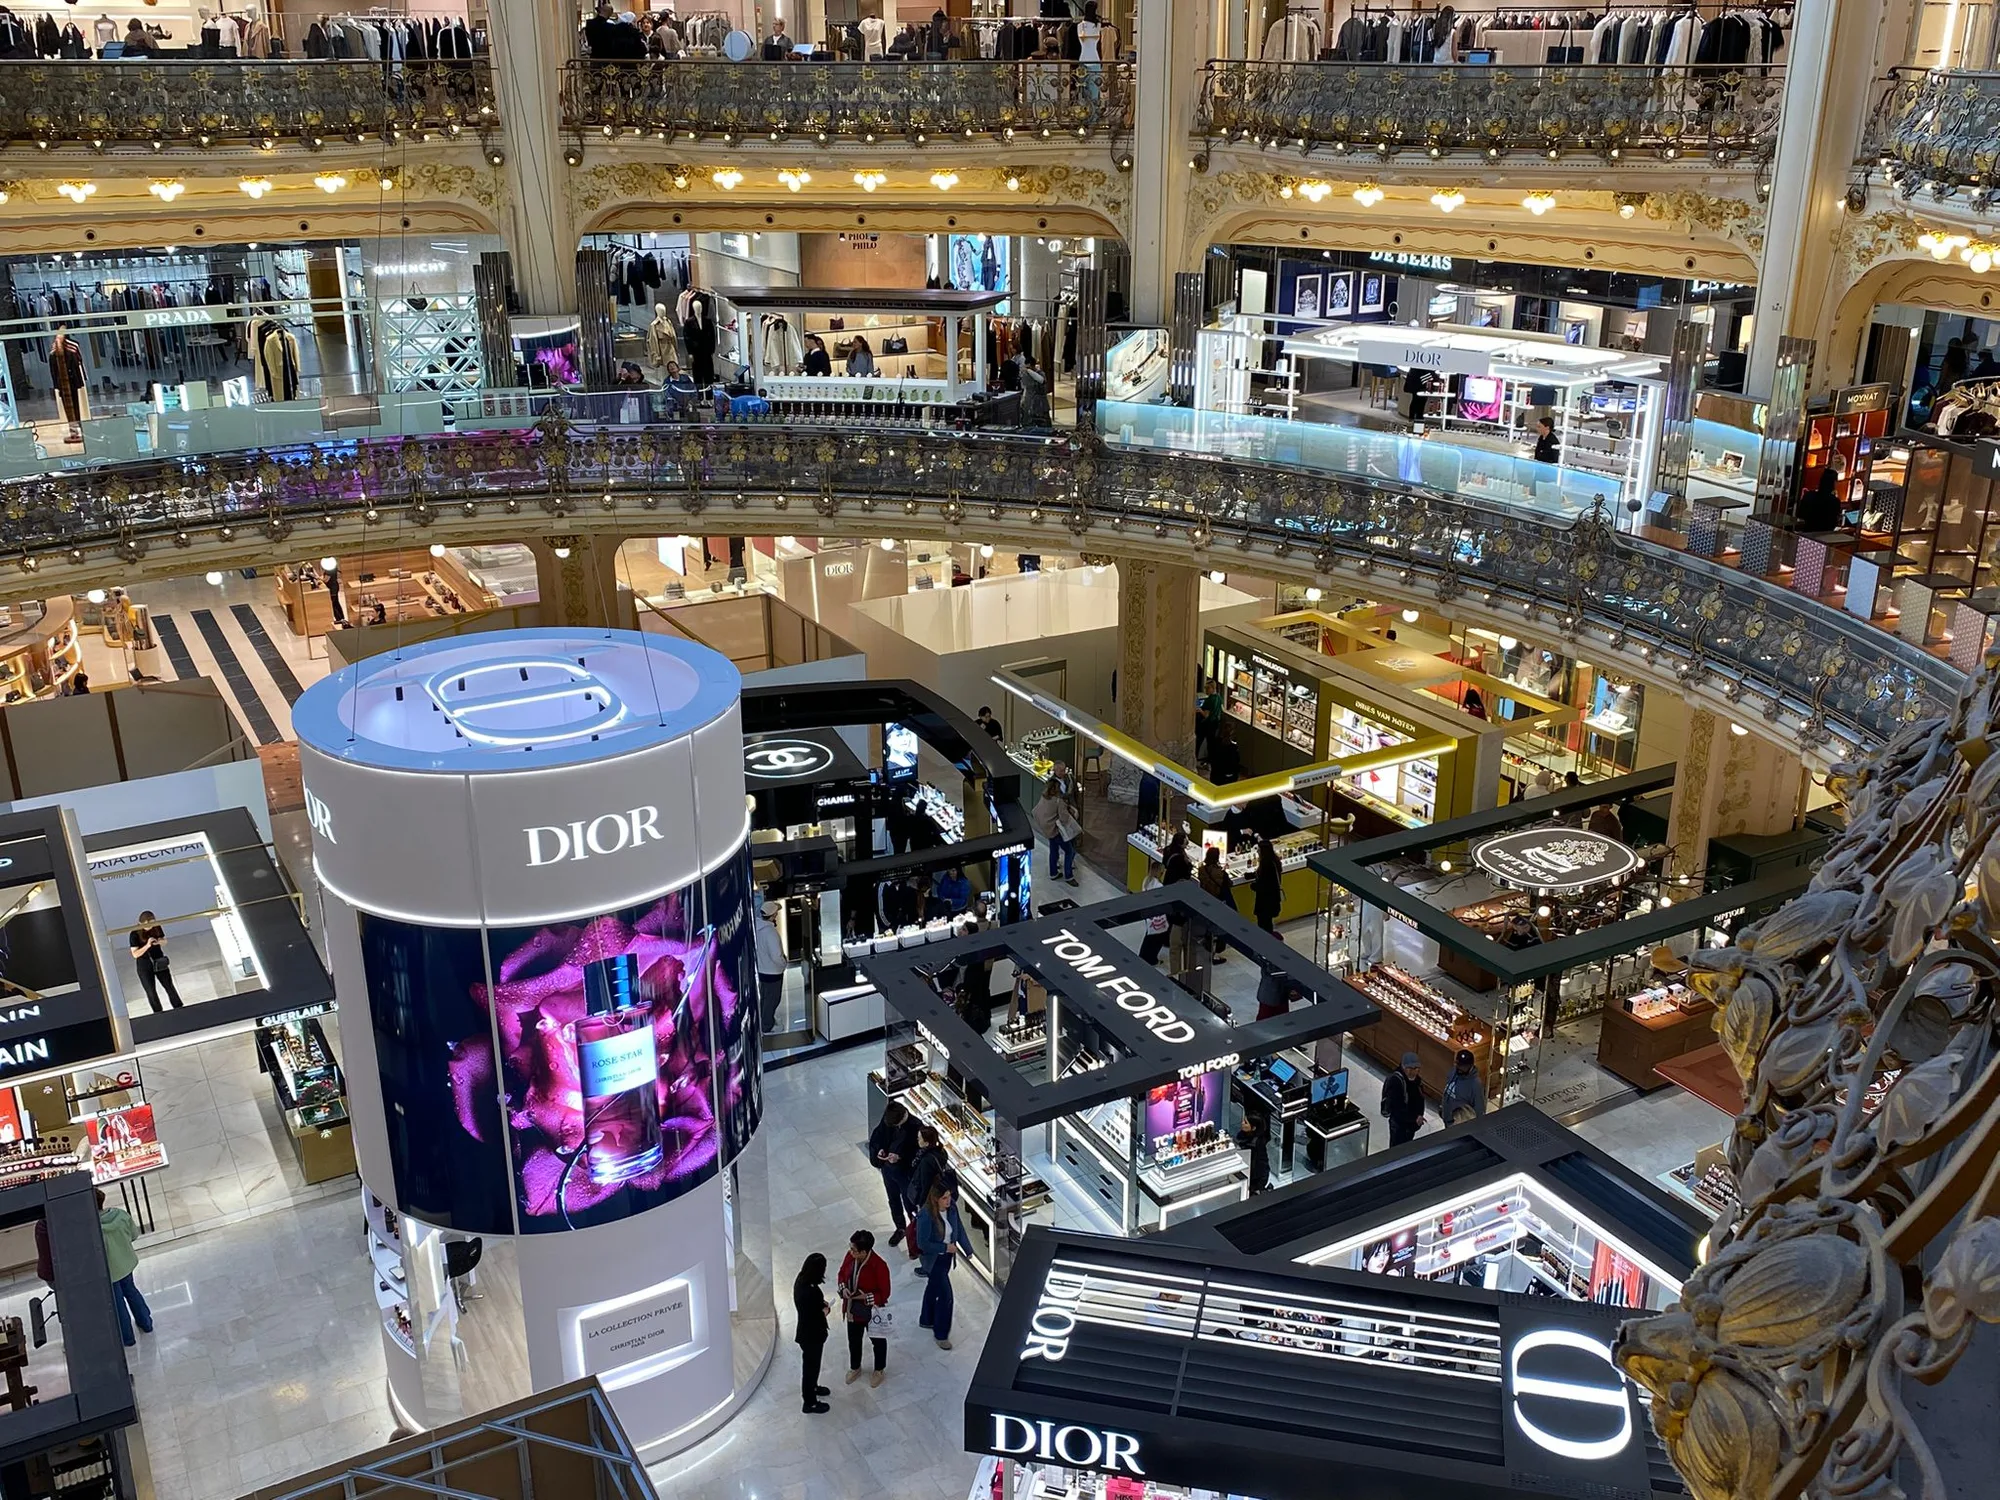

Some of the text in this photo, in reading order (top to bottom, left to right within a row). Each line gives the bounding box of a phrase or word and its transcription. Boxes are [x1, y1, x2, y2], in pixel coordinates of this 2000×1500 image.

[373, 262, 447, 276] GIVENCHY
[144, 310, 212, 326] PRADA
[1405, 349, 1441, 366] DIOR
[1847, 392, 1878, 404] MOYNAT
[825, 563, 853, 577] DIOR
[1355, 700, 1416, 732] DRIES VAN NOTEN
[817, 793, 855, 807] CHANEL
[524, 805, 664, 867] DIOR
[992, 843, 1027, 858] CHANEL
[1489, 848, 1558, 883] DIPTYQUE
[1041, 928, 1196, 1043] TOM FORD
[262, 1005, 324, 1027] GUERLAIN
[916, 1019, 950, 1060] TOM FORD
[591, 1048, 643, 1070] ROSE STAR
[1178, 1053, 1240, 1080] TOM FORD
[588, 1301, 683, 1339] LA COLLECTION PRIVÉE
[1020, 1267, 1088, 1361] DIOR
[609, 1329, 665, 1352] CHRISTIAN DIOR
[990, 1413, 1146, 1476] DIOR
